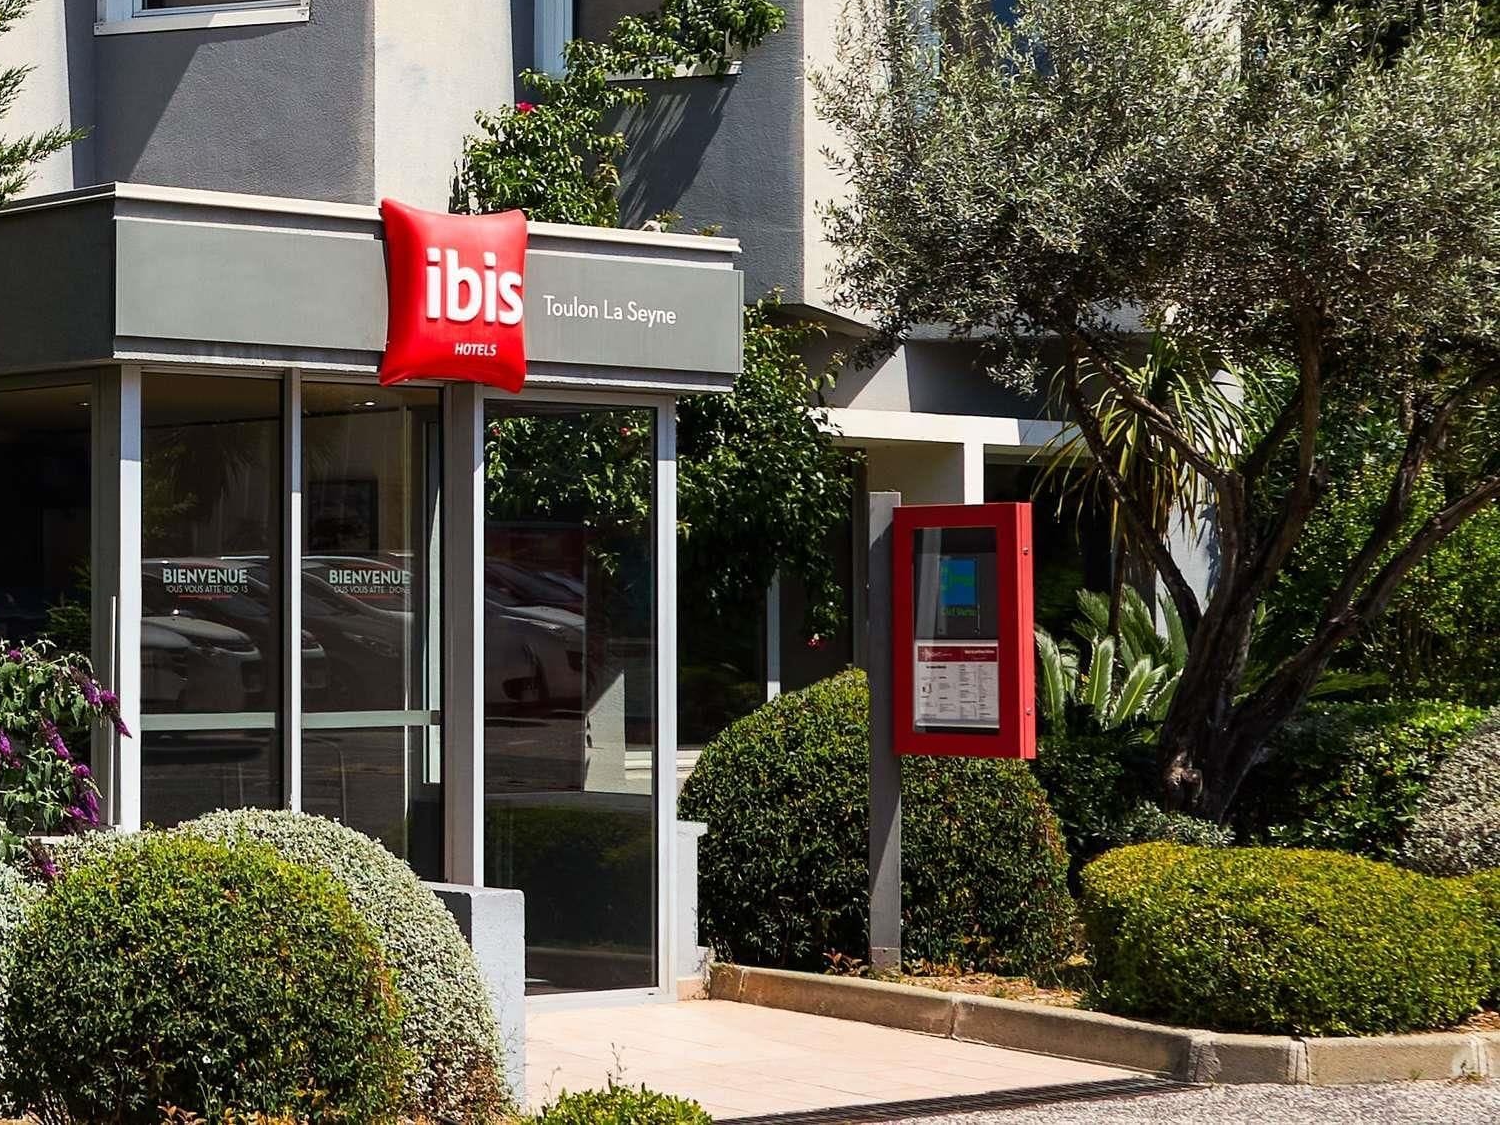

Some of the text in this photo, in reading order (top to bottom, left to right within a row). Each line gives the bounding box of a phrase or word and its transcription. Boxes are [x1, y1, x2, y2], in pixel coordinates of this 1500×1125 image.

[426, 248, 524, 325] ibis
[543, 295, 678, 329] Toulon La Seyne
[454, 343, 497, 357] HOTELS
[163, 568, 248, 584] BIENVENUE
[329, 569, 411, 584] BIENVENUE
